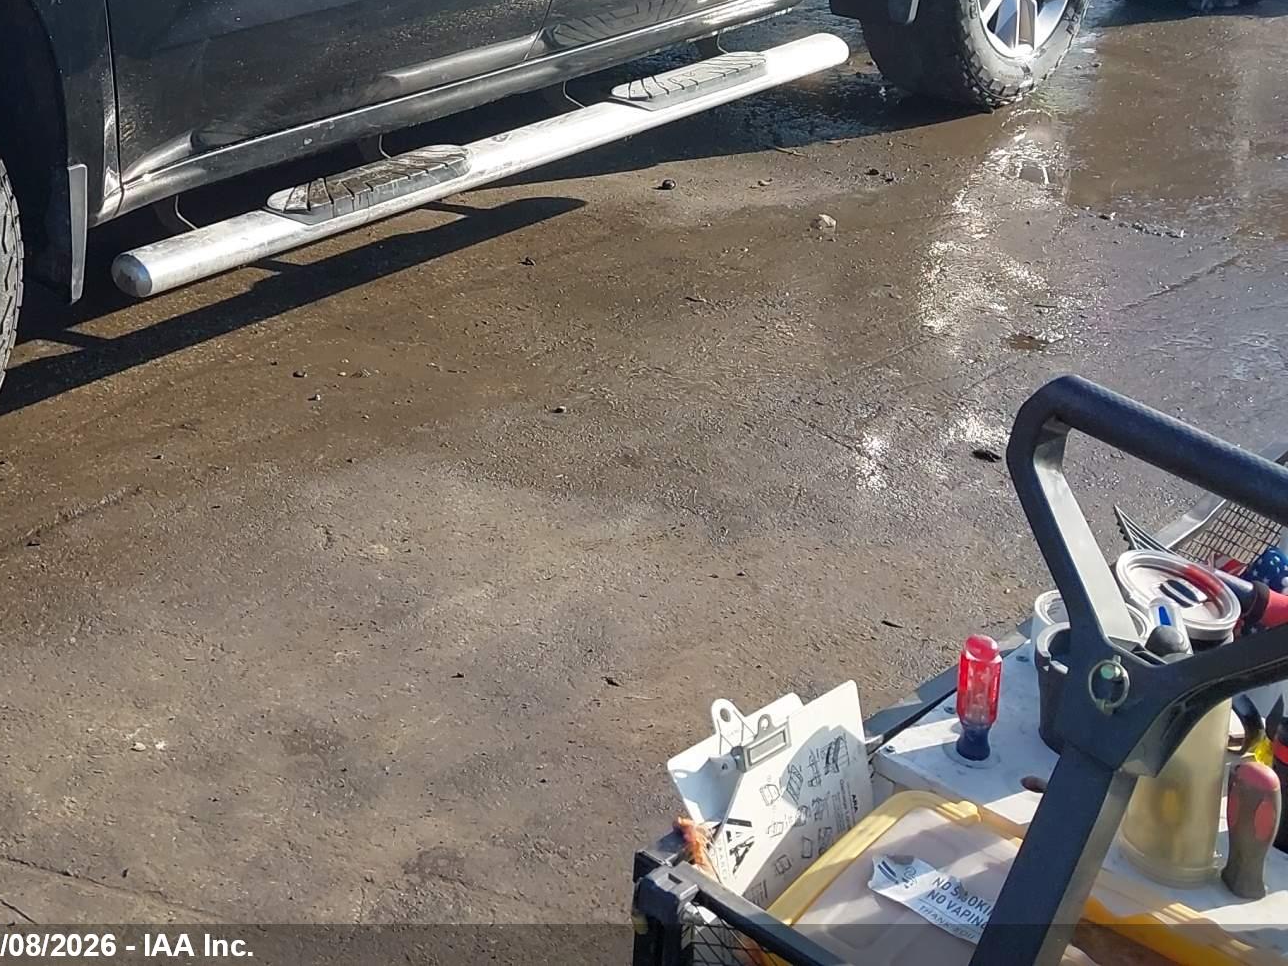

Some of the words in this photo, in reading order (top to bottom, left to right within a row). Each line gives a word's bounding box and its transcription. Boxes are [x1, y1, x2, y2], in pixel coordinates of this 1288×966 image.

[927, 889, 947, 905] NO
[932, 877, 952, 891] NO
[950, 885, 993, 916] SOKI
[919, 905, 950, 929] THANK
